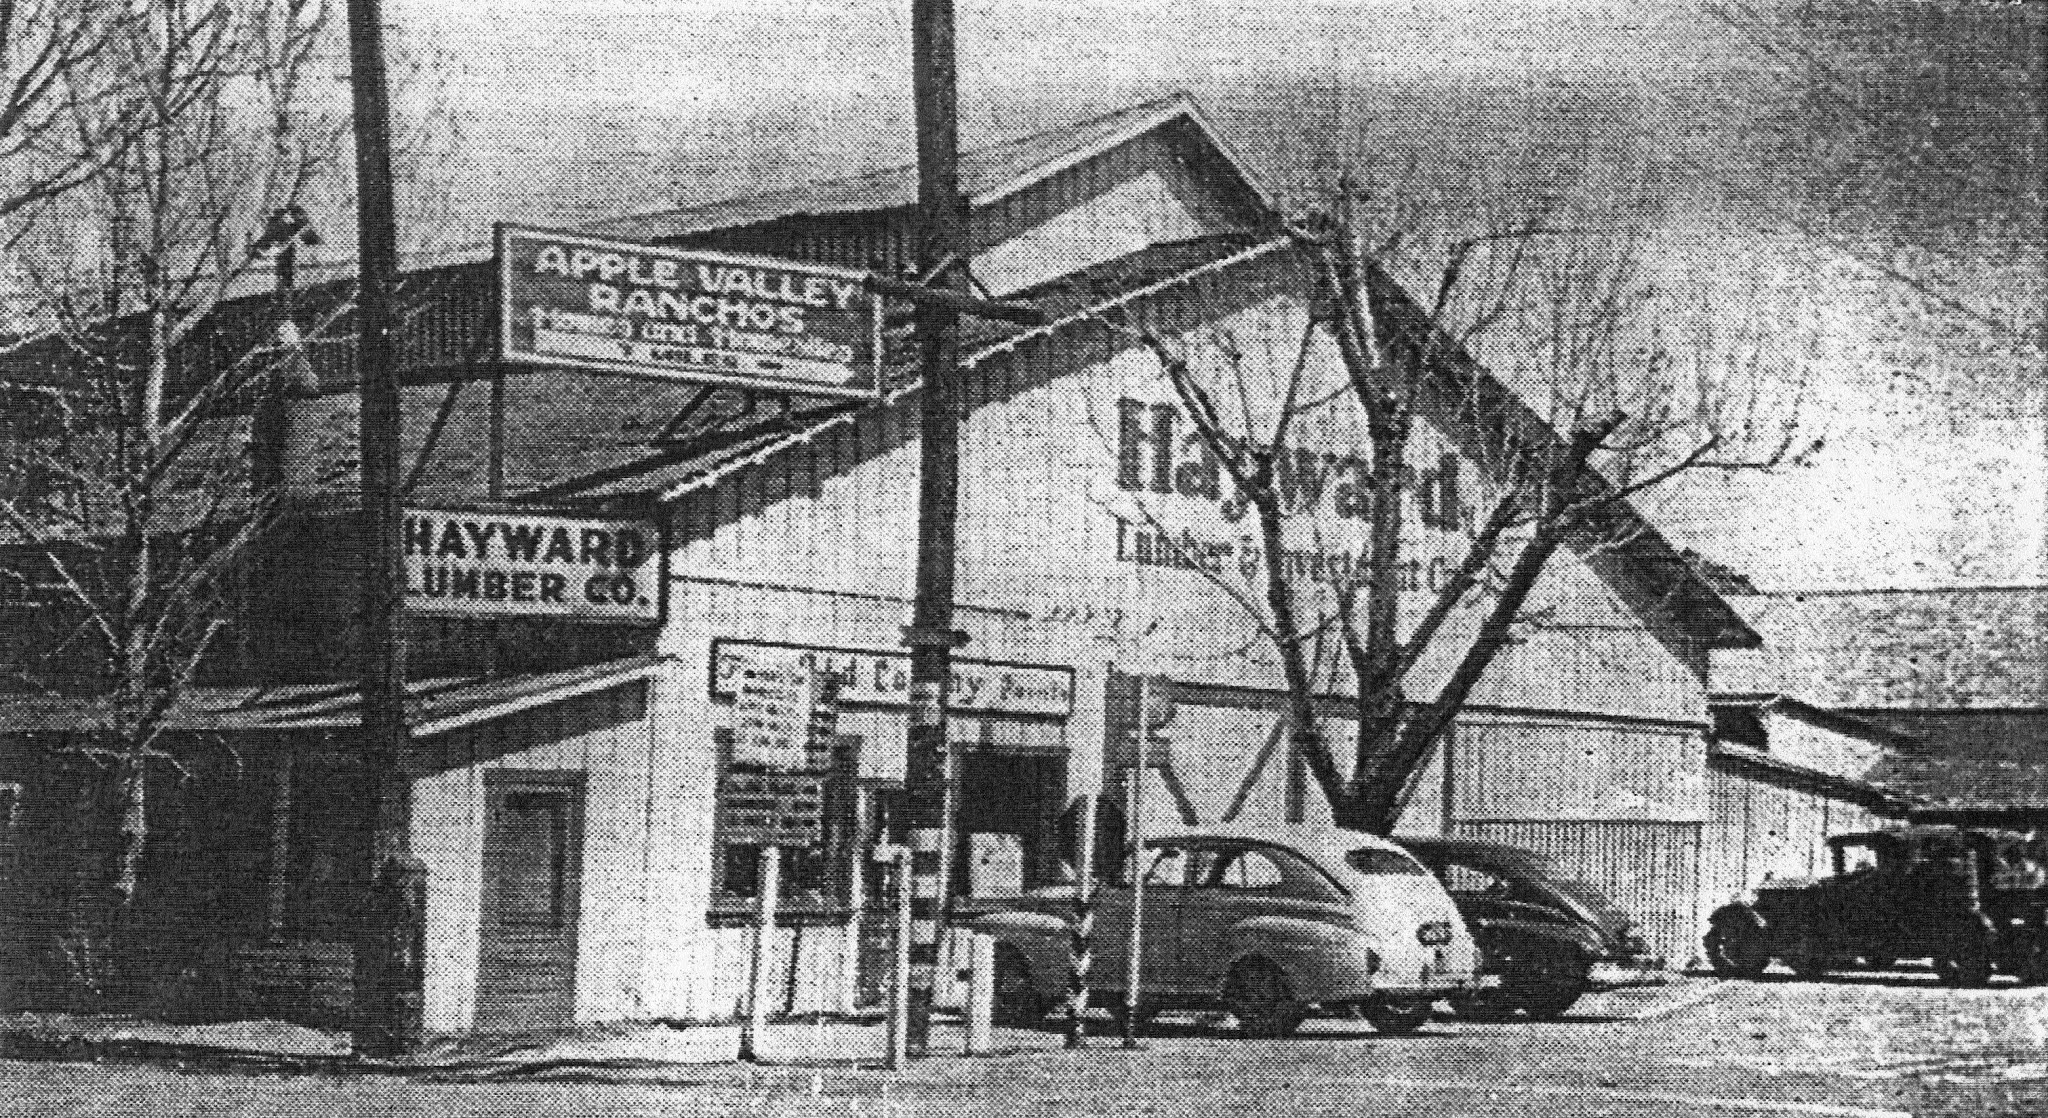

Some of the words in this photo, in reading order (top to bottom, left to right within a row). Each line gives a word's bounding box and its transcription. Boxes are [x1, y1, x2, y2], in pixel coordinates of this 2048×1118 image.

[535, 245, 680, 288] APPLE
[699, 265, 855, 309] VALLEY
[588, 283, 805, 335] RANCHOS
[642, 321, 698, 344] and
[403, 517, 646, 568] HAYWARD
[405, 565, 567, 602] UMBER
[1270, 548, 1422, 594] nvestnt
[874, 658, 984, 706] Cony
